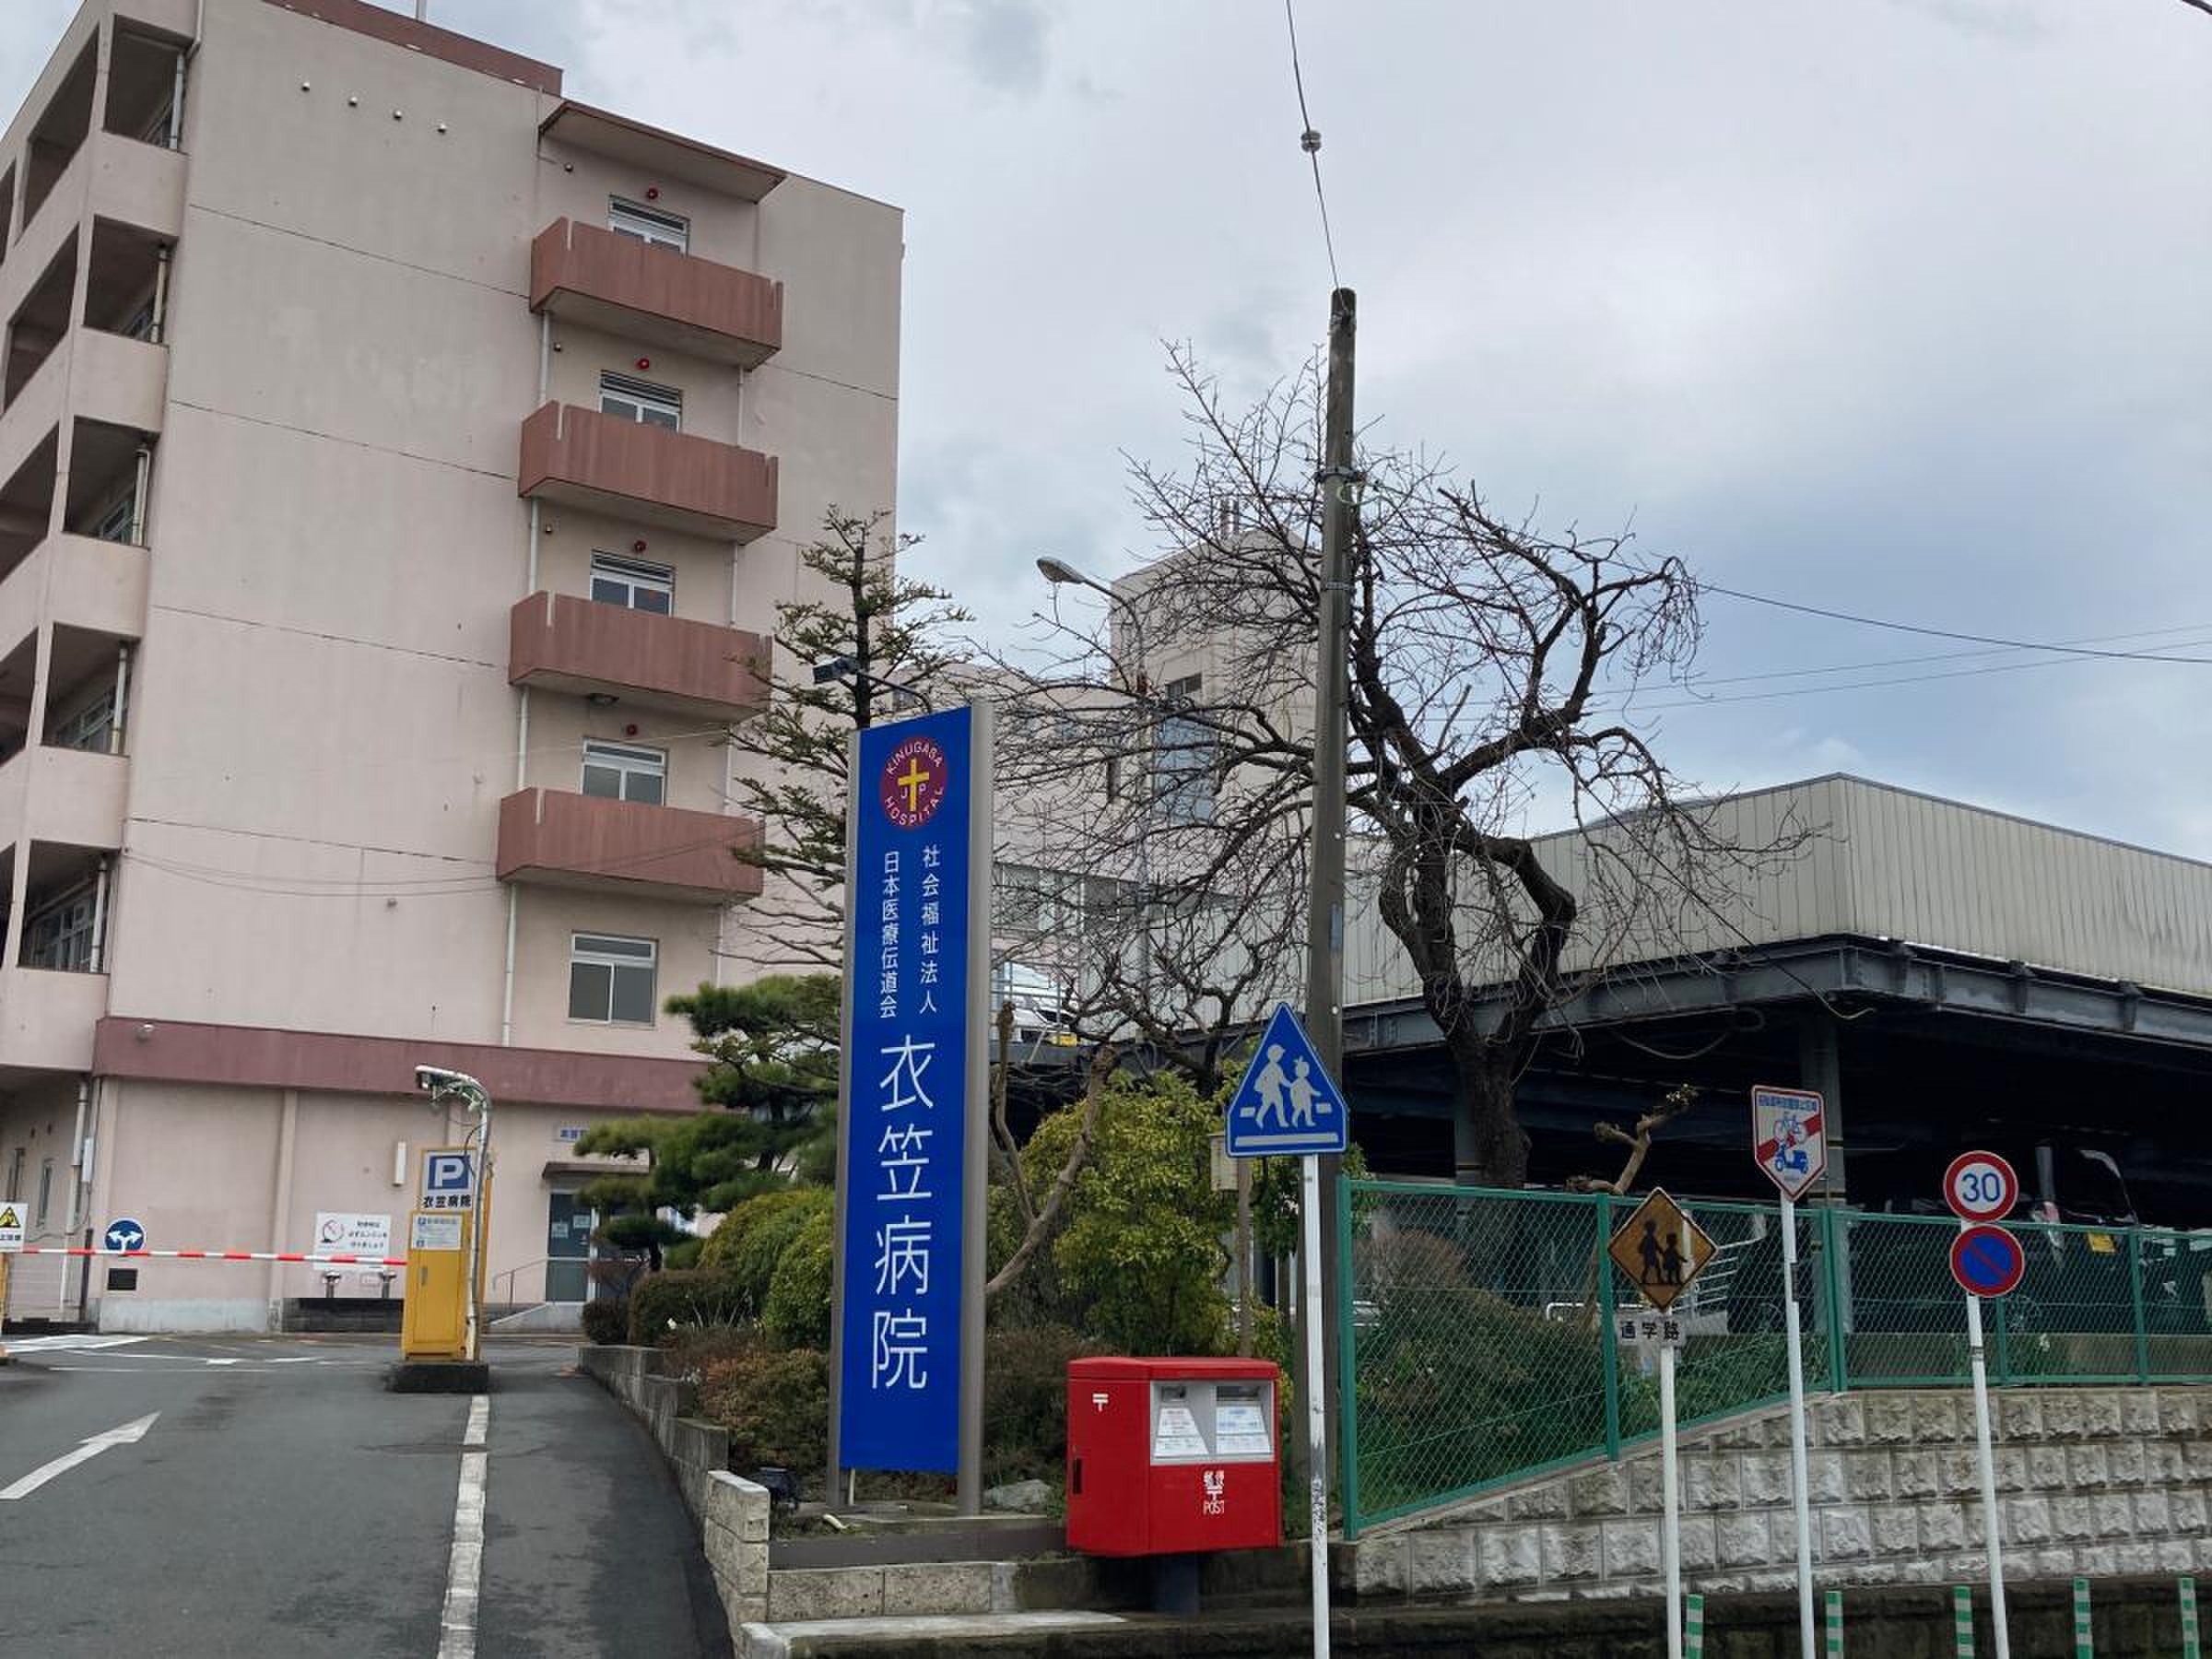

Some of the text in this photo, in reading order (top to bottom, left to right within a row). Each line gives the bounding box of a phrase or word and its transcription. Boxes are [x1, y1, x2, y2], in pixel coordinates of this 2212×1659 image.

[886, 741, 943, 775] KINUGASA
[885, 785, 945, 826] HOSPITAL
[880, 851, 900, 1018] 日本医療伝道会
[920, 844, 941, 1014] 社会福祉法人
[423, 1194, 471, 1208] 衣笠病院
[1960, 1172, 2001, 1203] 30
[872, 1034, 935, 1389] 衣笠病院
[1620, 1321, 1679, 1340] 通学路
[1203, 1500, 1225, 1515] POST
